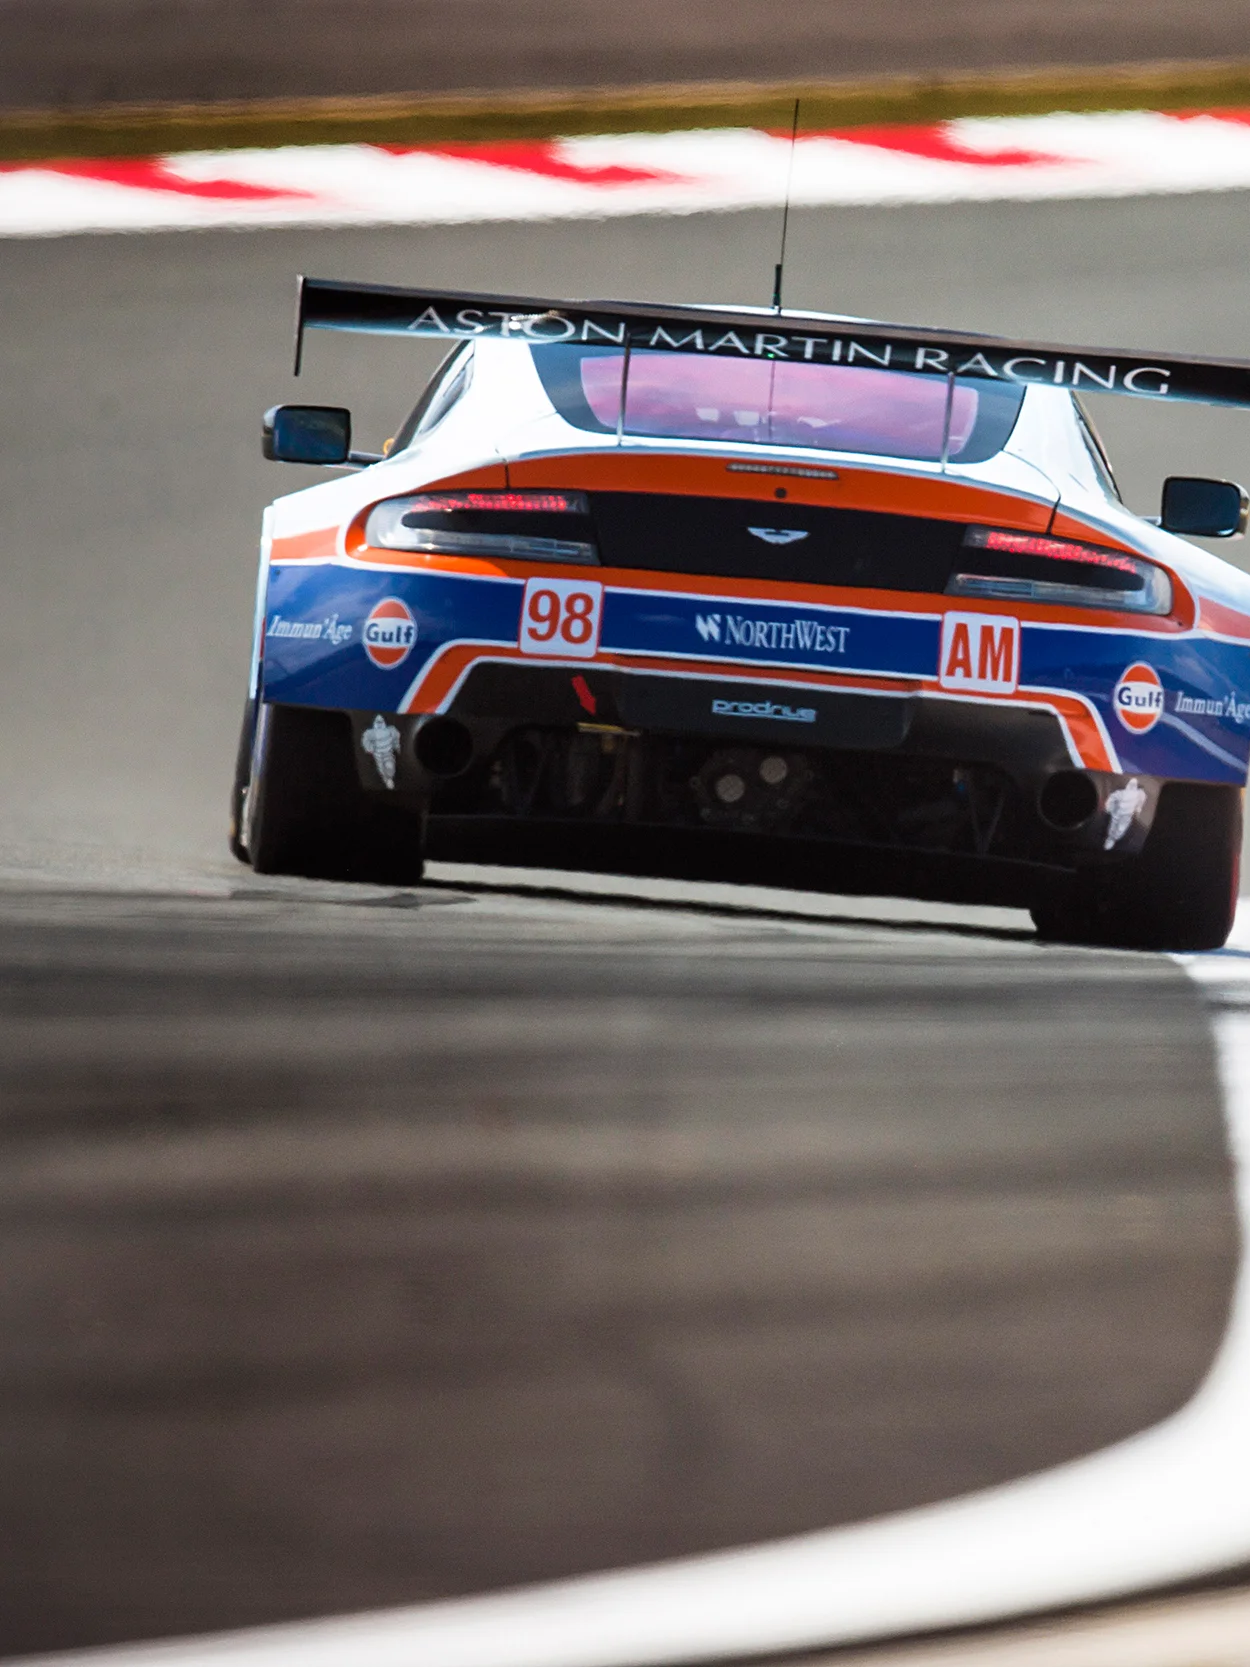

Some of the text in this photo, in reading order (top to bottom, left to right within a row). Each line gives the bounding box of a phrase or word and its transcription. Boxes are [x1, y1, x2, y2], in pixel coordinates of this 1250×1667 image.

[408, 305, 1172, 395] ASTON MARTIN RACING
[365, 621, 415, 647] Gulf
[527, 589, 595, 644] 98
[945, 621, 1015, 683] AM
[1117, 685, 1164, 710] Gulf
